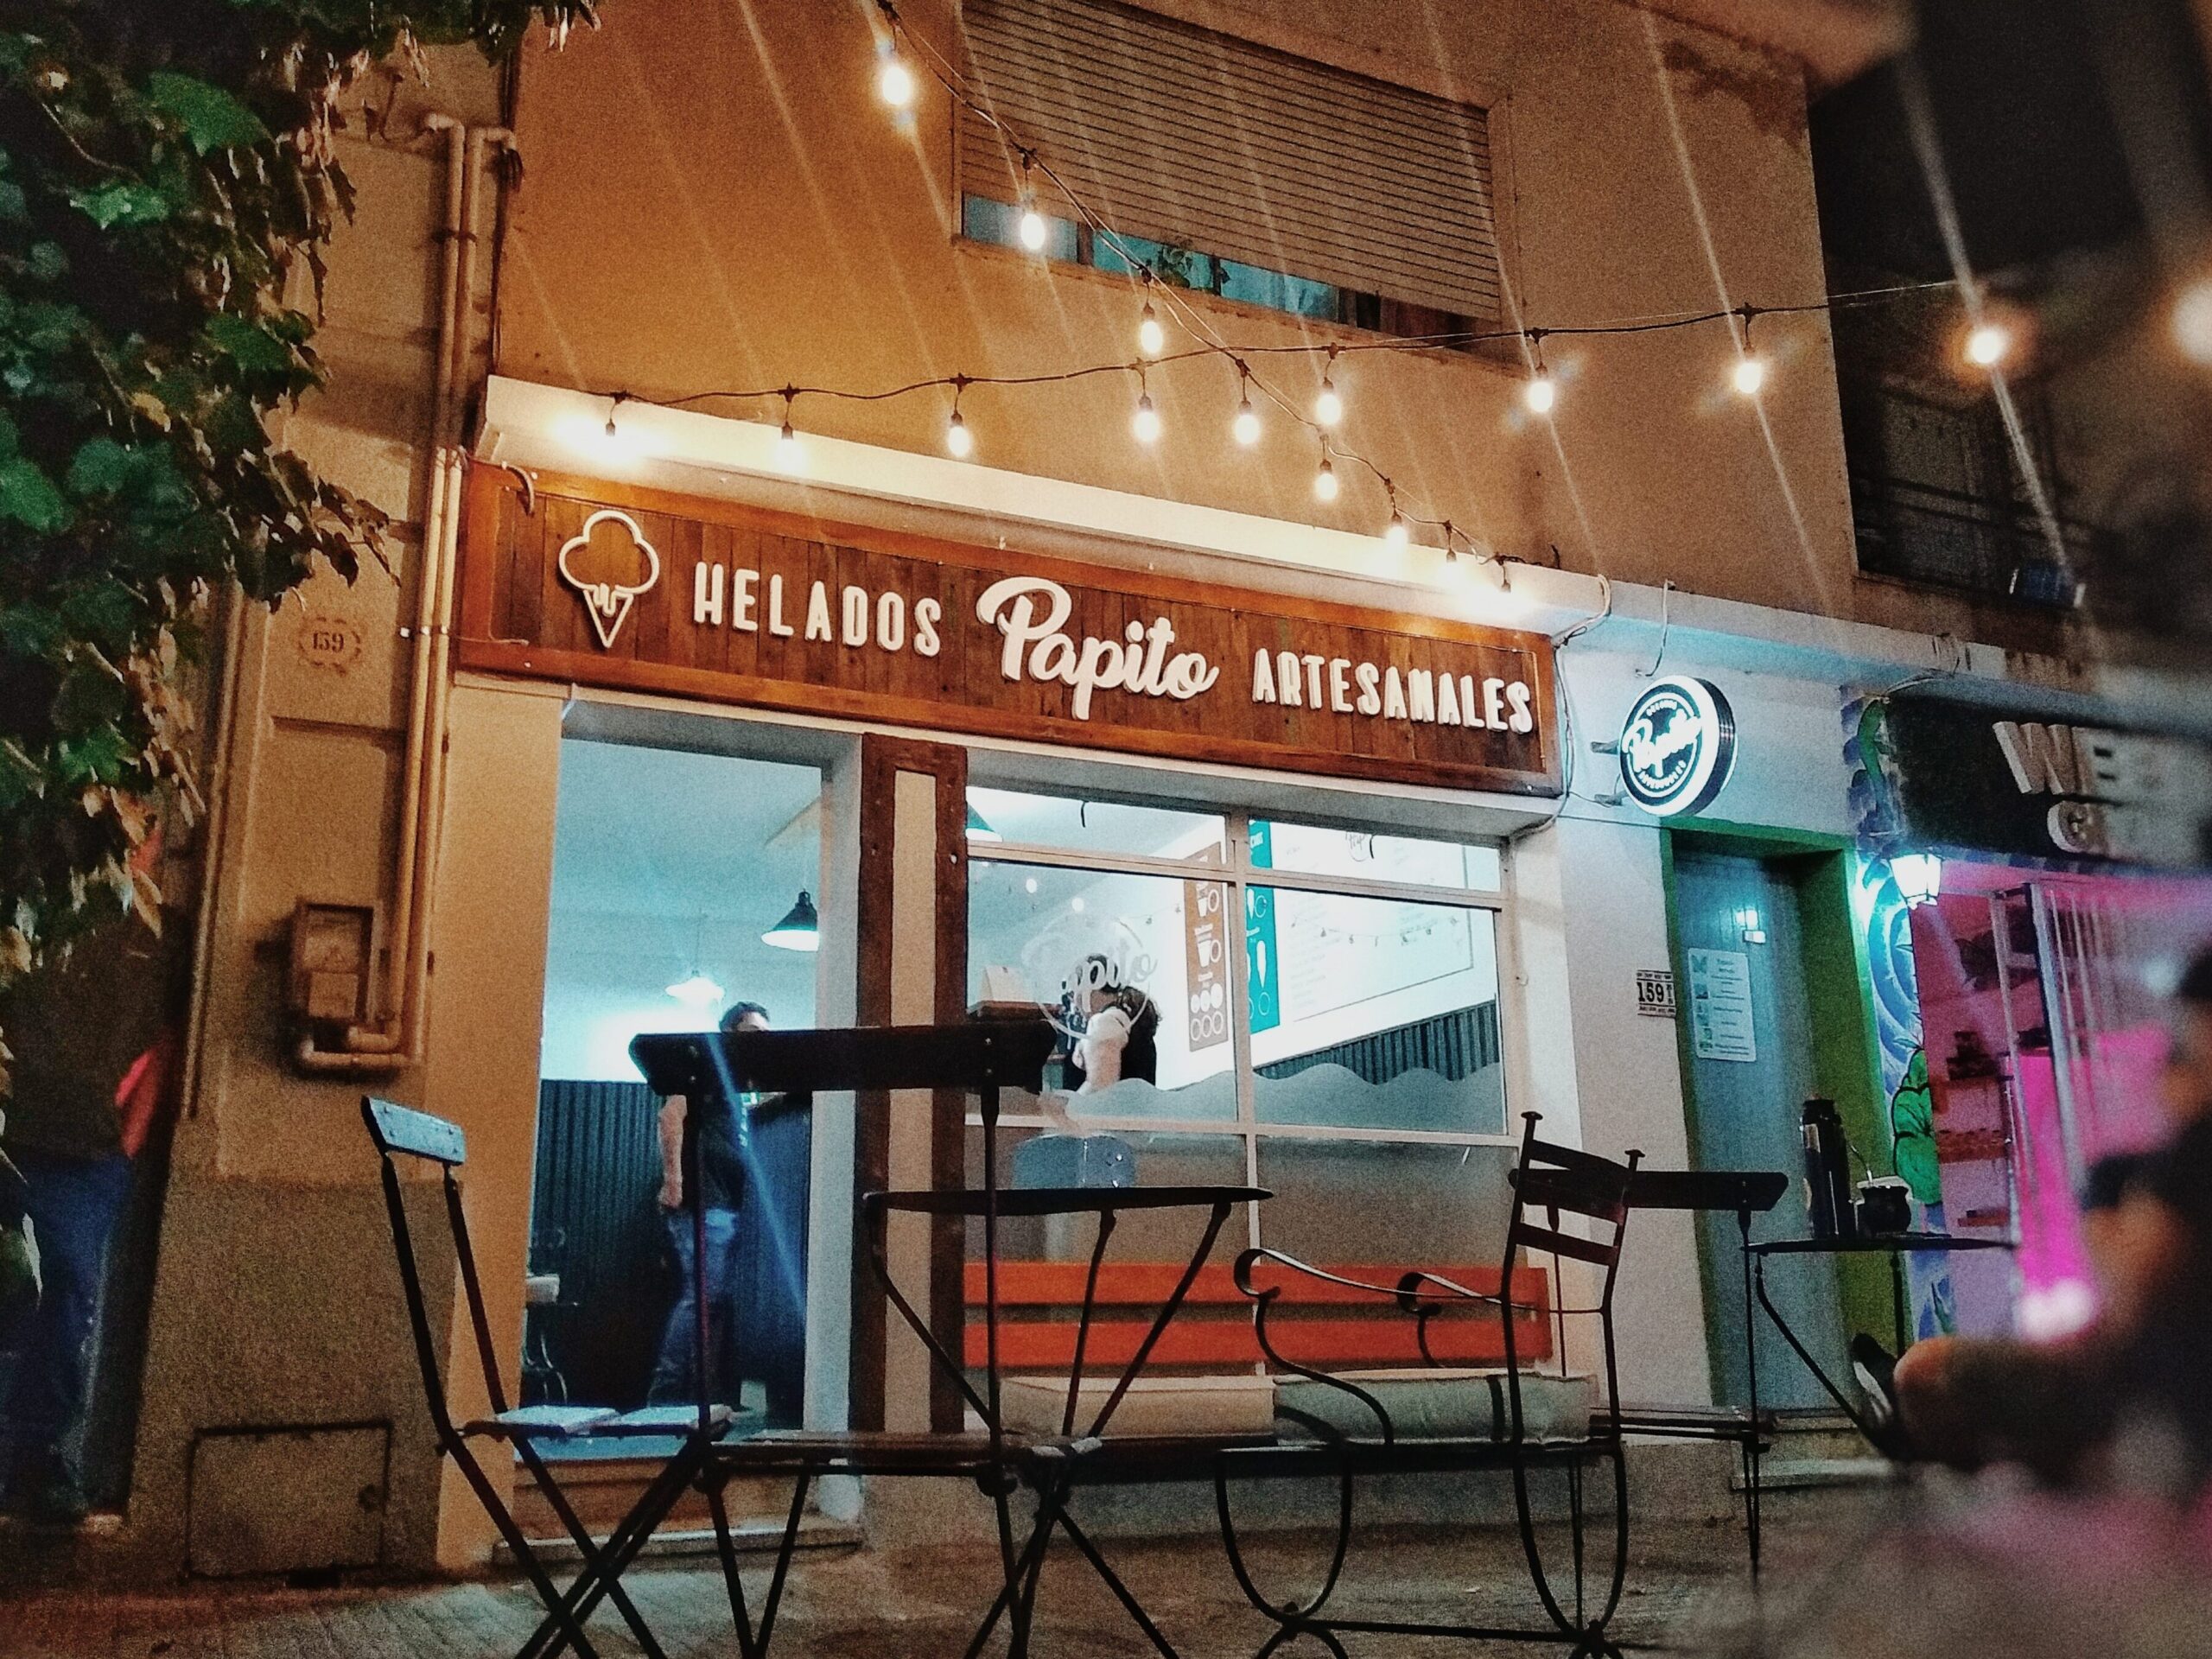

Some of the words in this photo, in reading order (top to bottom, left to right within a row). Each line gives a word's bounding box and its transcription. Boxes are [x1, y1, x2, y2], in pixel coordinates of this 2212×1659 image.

[313, 631, 344, 652] 159
[694, 562, 942, 657] HELADOS
[976, 577, 1219, 720] Papito
[1253, 648, 1533, 734] ARTESANALES
[1637, 982, 1664, 1003] 159
